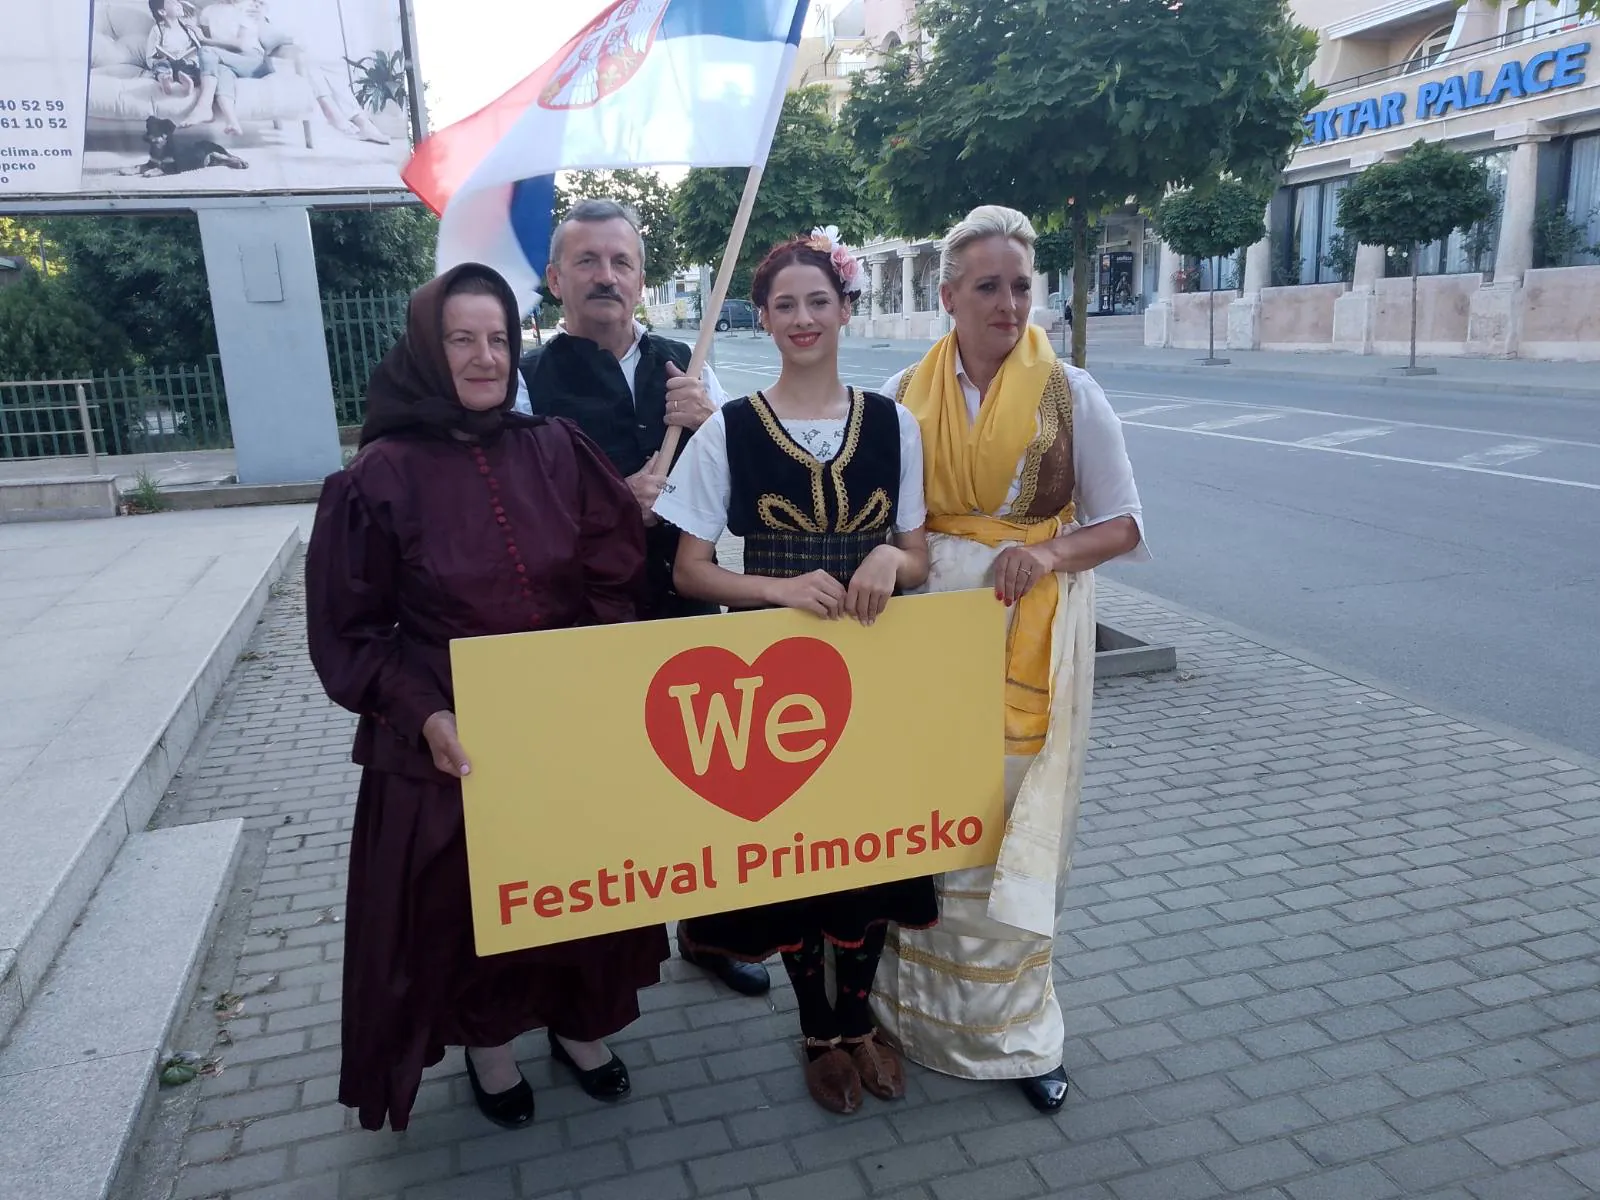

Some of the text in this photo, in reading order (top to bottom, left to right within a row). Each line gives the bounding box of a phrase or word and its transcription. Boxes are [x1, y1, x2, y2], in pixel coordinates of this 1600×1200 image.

[1415, 41, 1592, 120] PALACE
[21, 99, 41, 112] 52
[45, 99, 65, 112] 59
[0, 117, 68, 129] 61 10 52
[0, 146, 73, 157] clima.com
[0, 162, 36, 173] рско
[668, 675, 827, 777] We
[498, 809, 984, 926] Festival Primorsko
